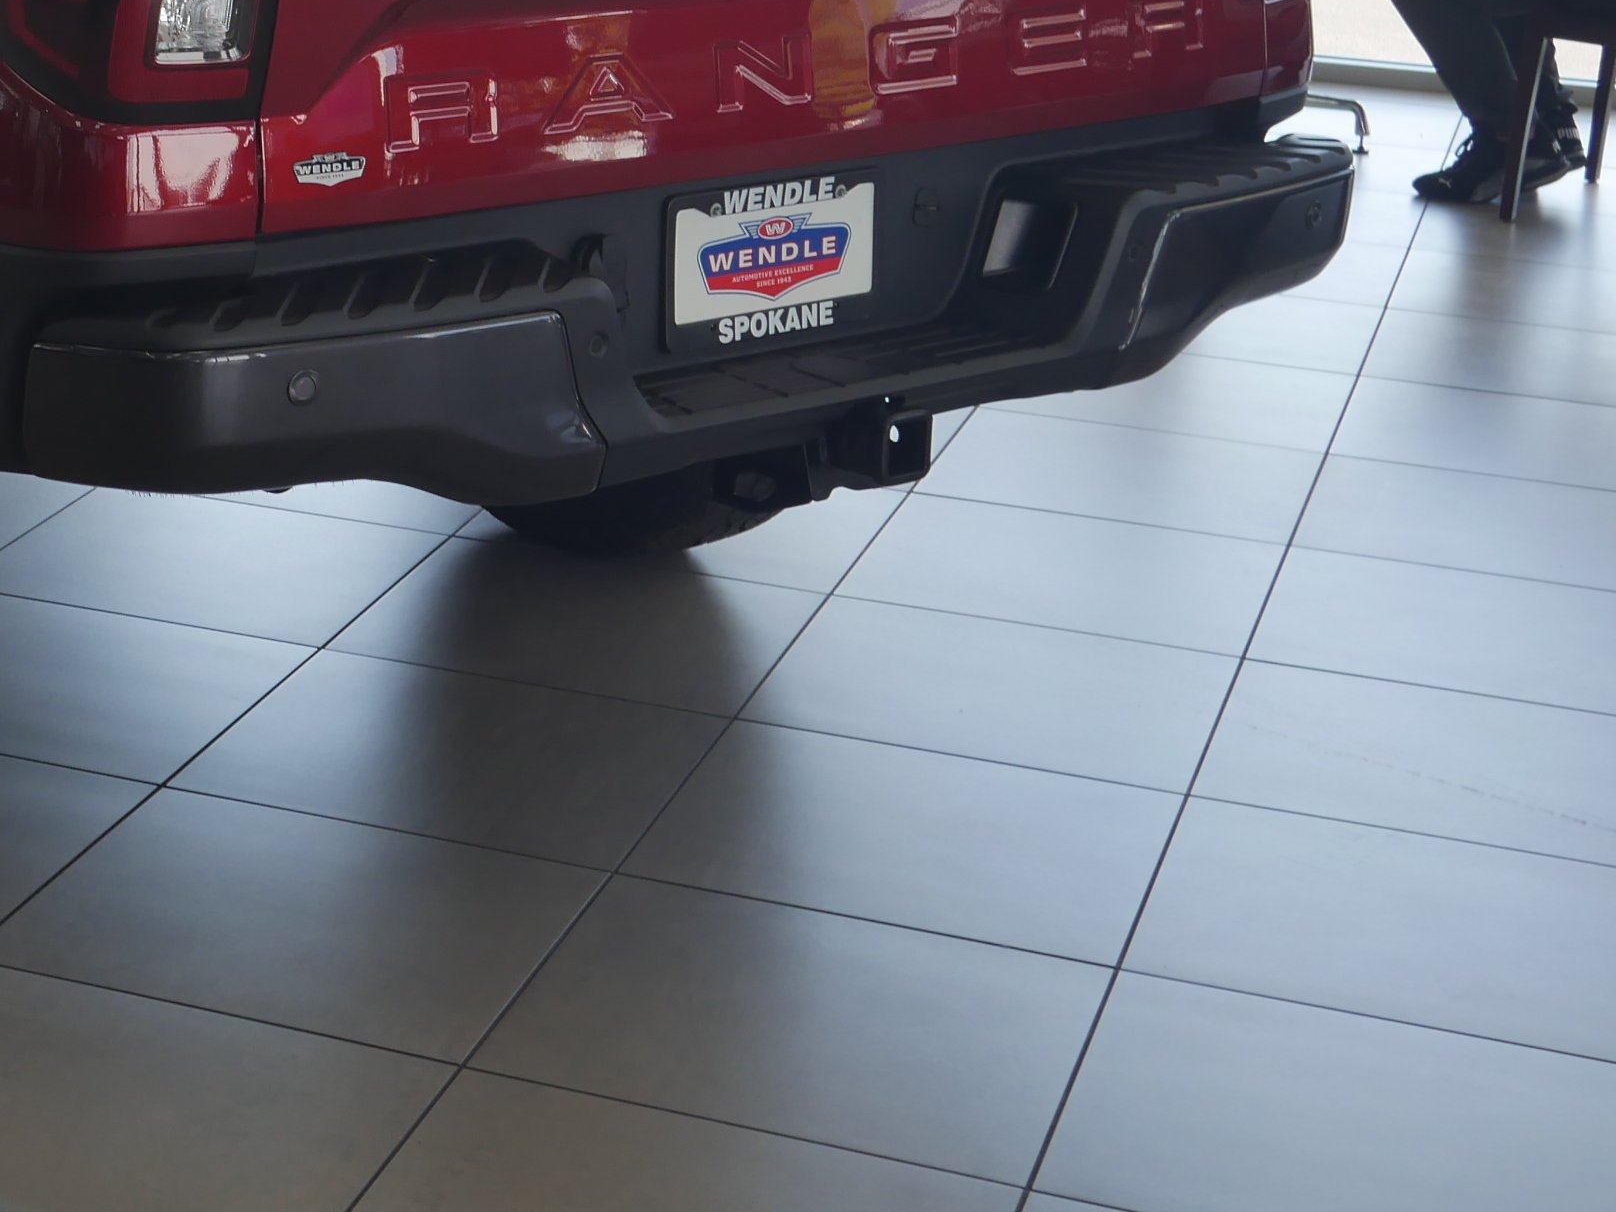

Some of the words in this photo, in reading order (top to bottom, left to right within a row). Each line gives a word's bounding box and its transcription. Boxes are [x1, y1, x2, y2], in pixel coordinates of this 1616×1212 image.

[385, 0, 1204, 155] RANGER
[295, 160, 360, 175] WENDLE
[724, 176, 835, 215] WENDLE
[765, 222, 786, 236] W
[708, 236, 837, 273] WENDLE
[732, 269, 773, 283] AUTOMOTIVE
[774, 264, 814, 276] EXCELLENCE
[756, 280, 776, 288] SINCE
[718, 300, 834, 345] SPOKANE
